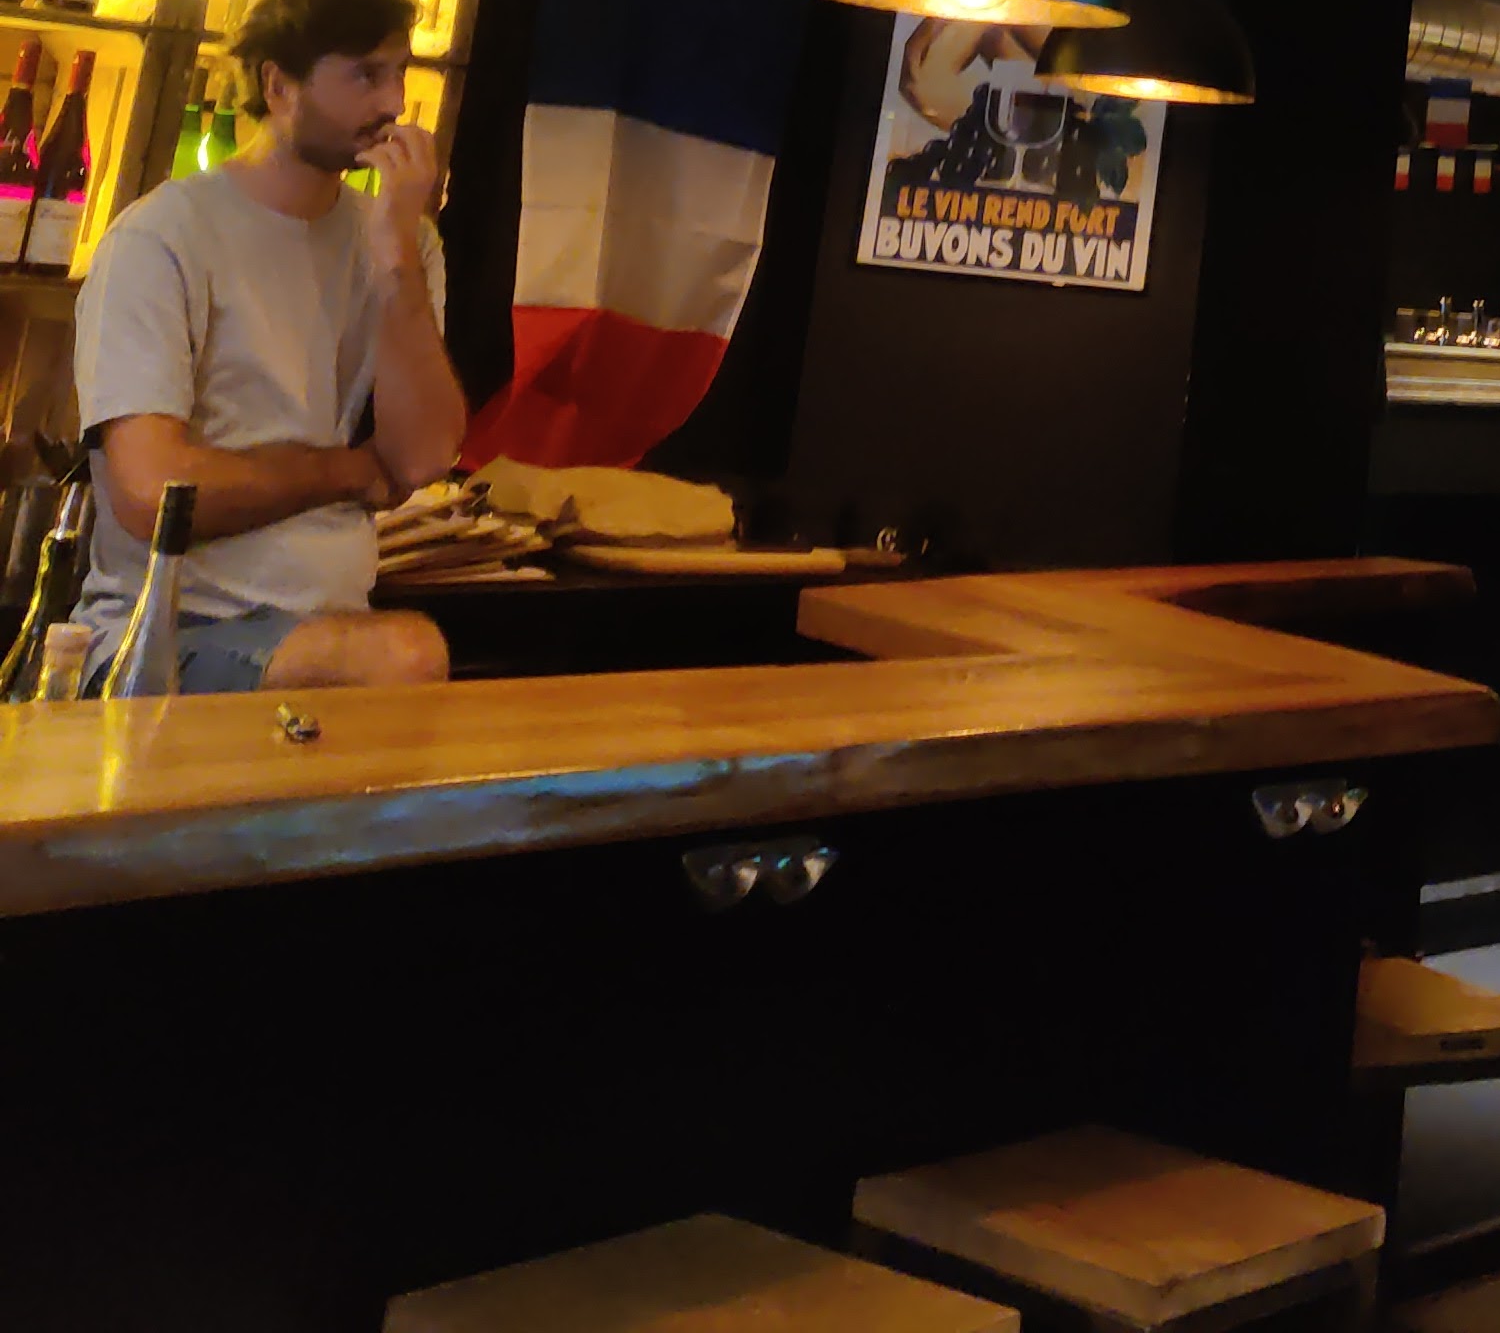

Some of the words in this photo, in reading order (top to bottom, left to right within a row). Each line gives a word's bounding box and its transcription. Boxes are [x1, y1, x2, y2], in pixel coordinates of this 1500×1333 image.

[898, 187, 929, 218] LE
[935, 189, 979, 222] VIN
[984, 195, 1050, 229] REND
[877, 218, 1014, 268] BUVONS
[1021, 232, 1066, 273] DU
[1073, 236, 1132, 280] VIN
